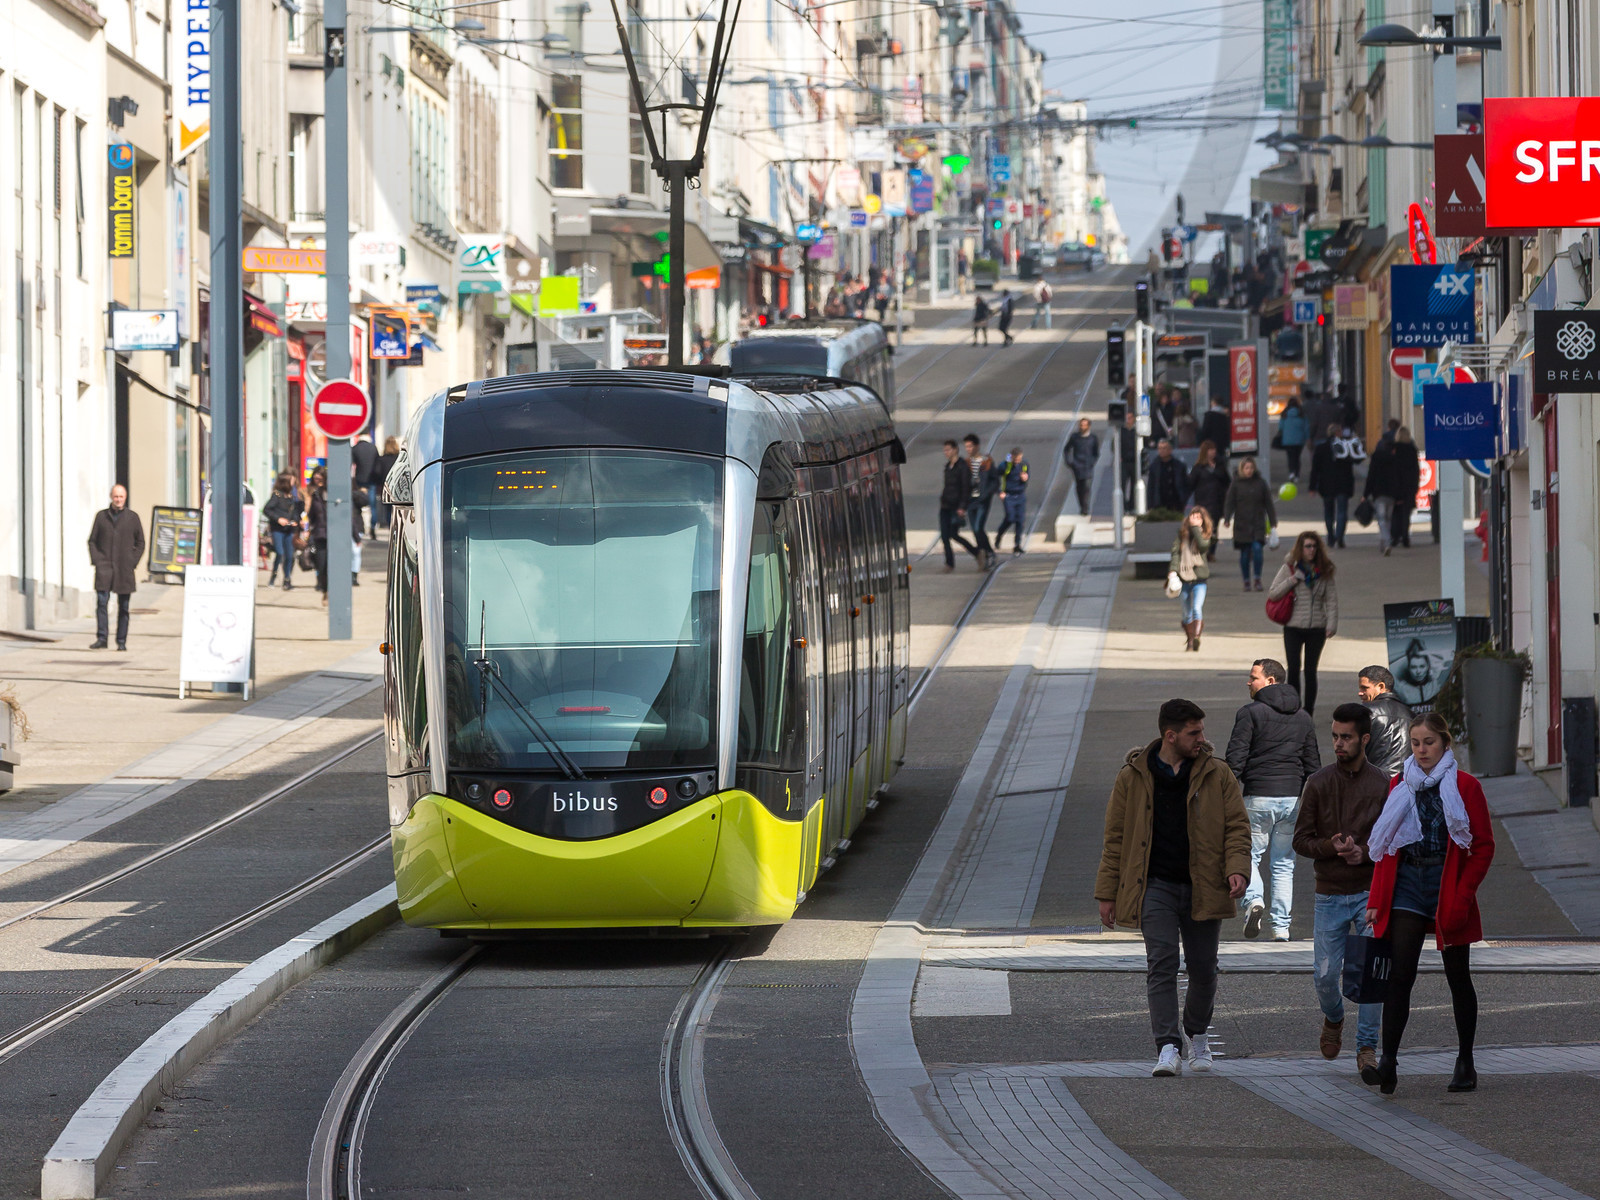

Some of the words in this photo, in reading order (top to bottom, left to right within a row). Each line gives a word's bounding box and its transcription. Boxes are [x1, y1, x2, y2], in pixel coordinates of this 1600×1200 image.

[1515, 140, 1600, 183] SFR
[109, 175, 133, 211] bara
[109, 212, 133, 257] tamm
[253, 252, 323, 268] NICOLAS
[1396, 321, 1469, 331] BANQUE
[1396, 333, 1469, 343] POPULAIRE
[1434, 412, 1485, 426] Nocibé
[196, 576, 243, 584] PANDORA
[553, 791, 619, 812] bibus
